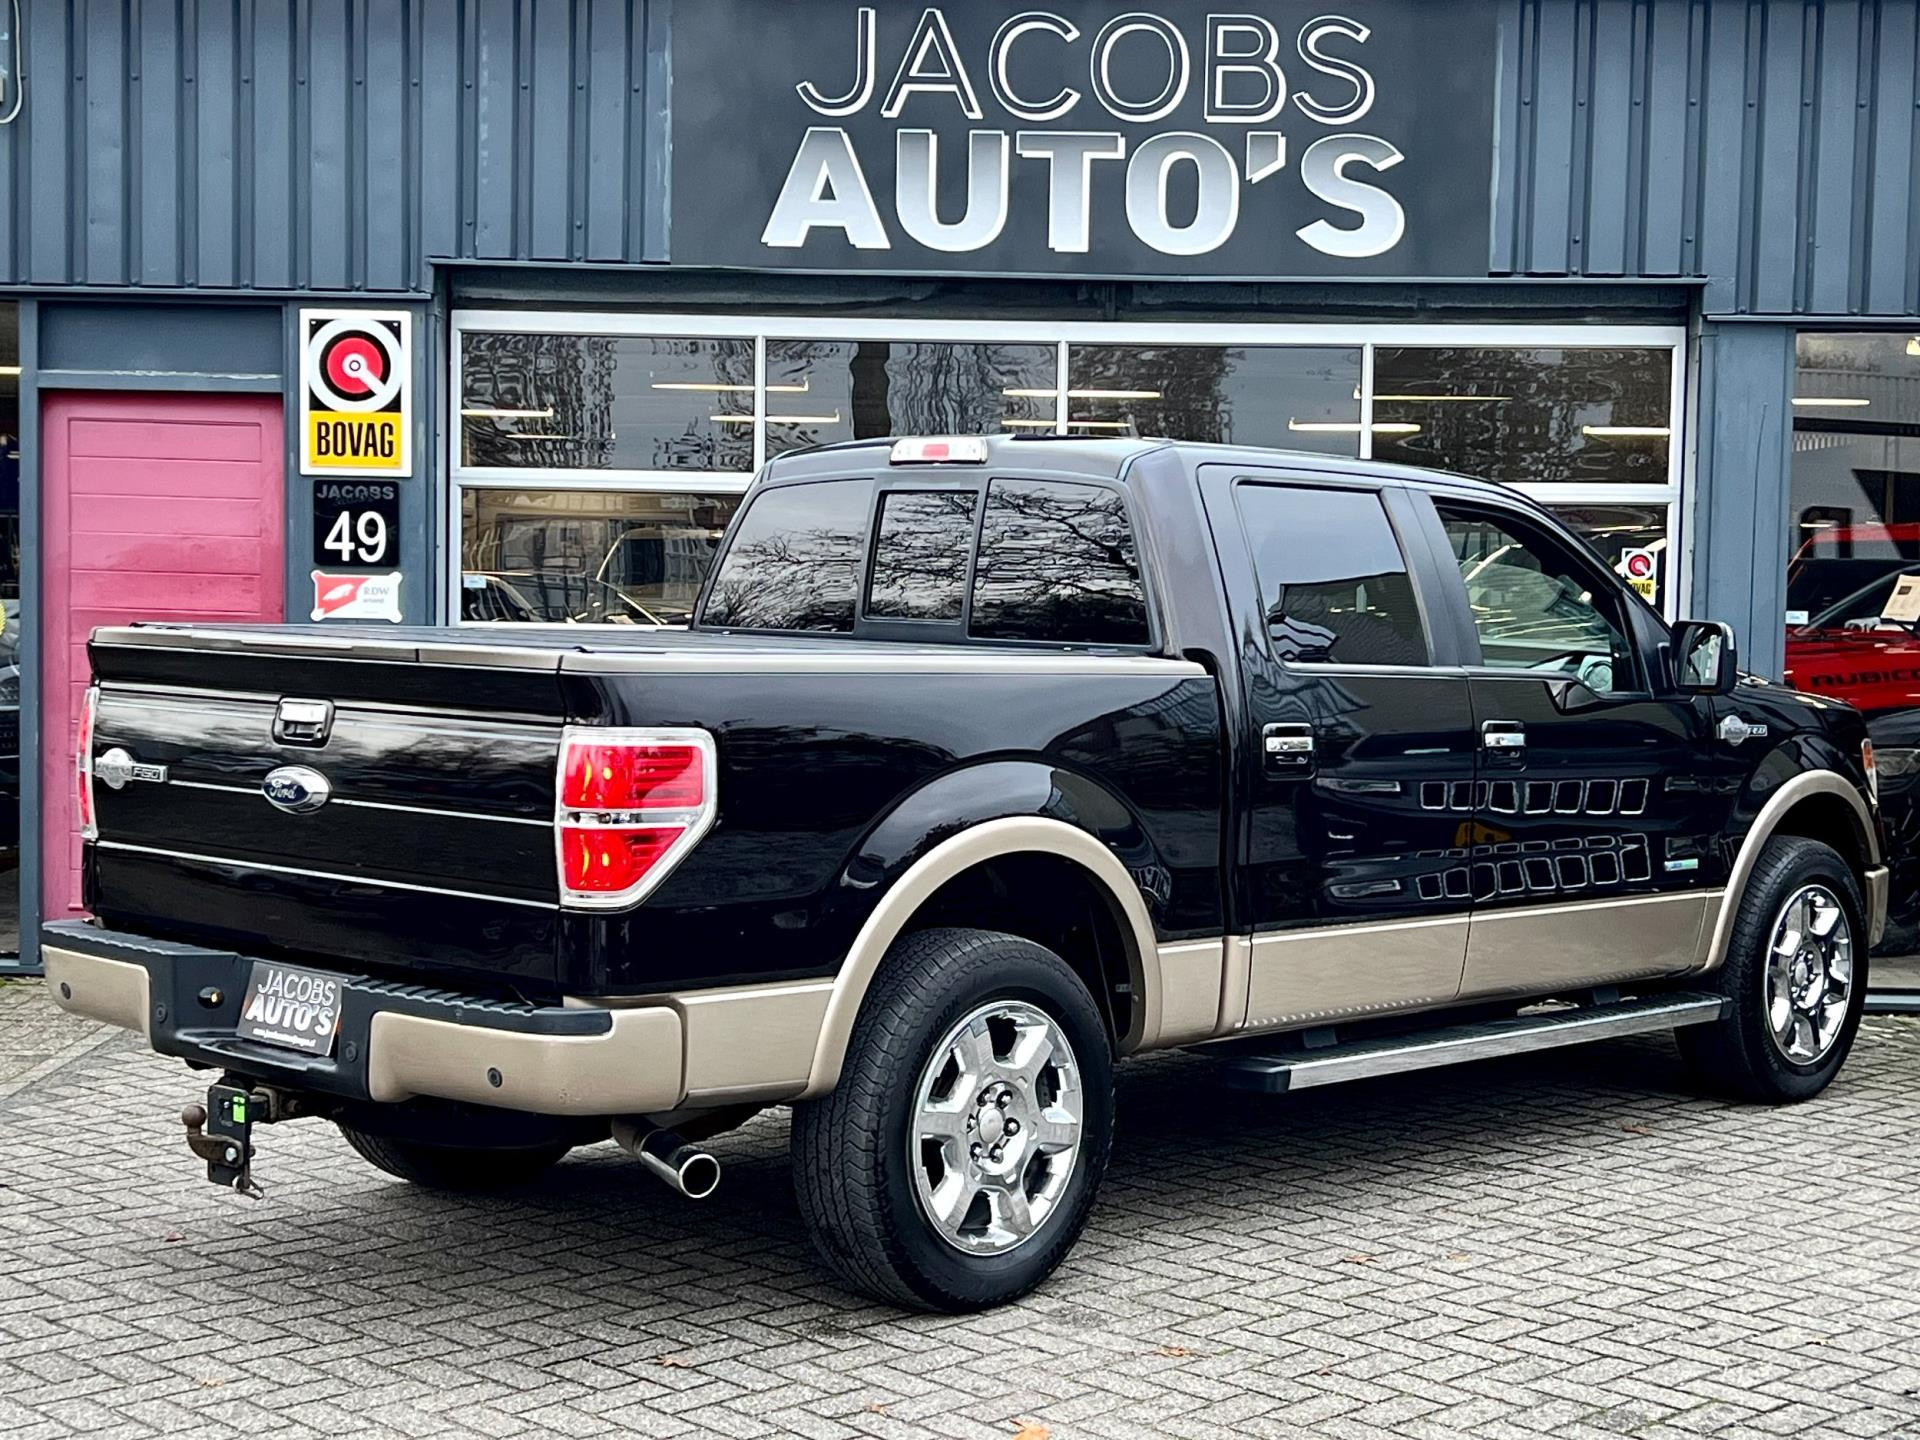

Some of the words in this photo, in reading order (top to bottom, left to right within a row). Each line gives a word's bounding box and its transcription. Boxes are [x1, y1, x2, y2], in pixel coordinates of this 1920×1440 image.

[796, 7, 1376, 126] JACOBS
[760, 126, 1406, 258] AUTO'S
[316, 421, 394, 458] BOVAG
[316, 484, 394, 500] JACOBS
[324, 510, 387, 563] 49
[269, 778, 298, 799] Ford
[257, 969, 336, 1006] JACOBS
[244, 993, 334, 1036] AUTO'S
